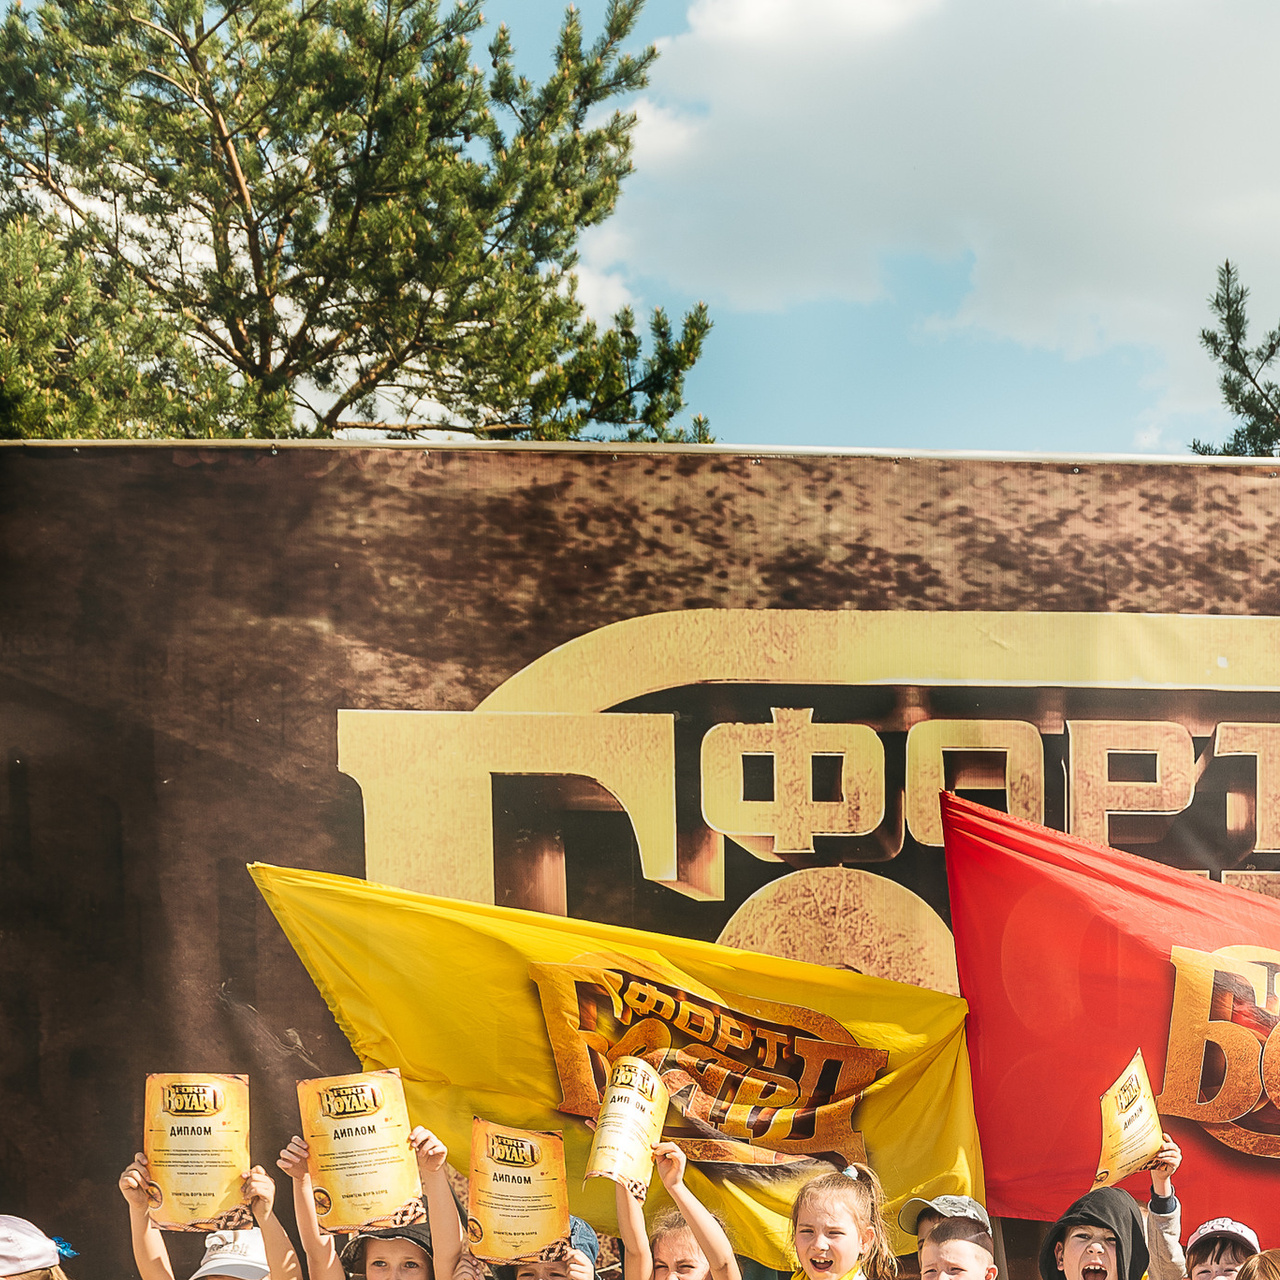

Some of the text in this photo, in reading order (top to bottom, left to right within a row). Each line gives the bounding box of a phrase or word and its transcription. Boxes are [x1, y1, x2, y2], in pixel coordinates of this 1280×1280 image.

[624, 981, 789, 1069] ФОРТ
[610, 1095, 646, 1113] ДИПОМ
[170, 1126, 212, 1137] ДИПЛОМ
[333, 1125, 377, 1140] ДИПЛОМ
[492, 1172, 531, 1184] ДИПЛОМ
